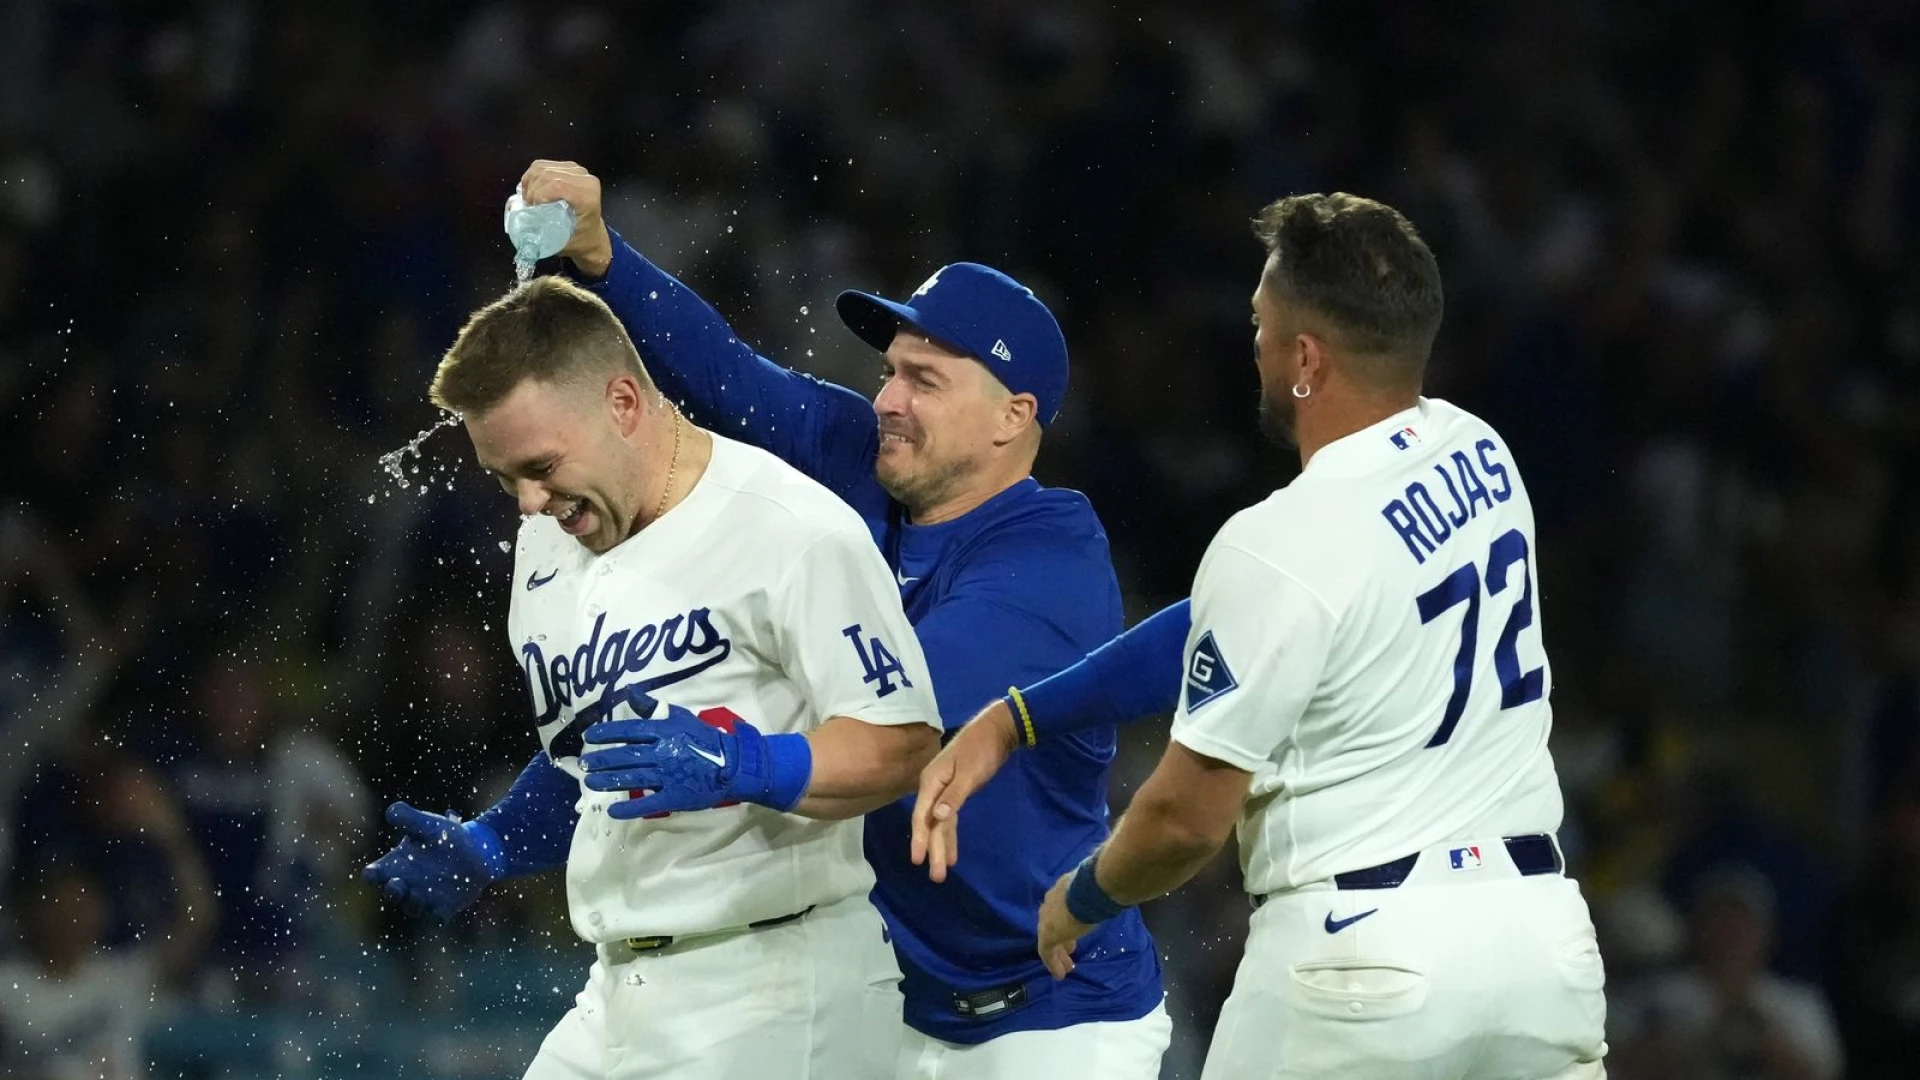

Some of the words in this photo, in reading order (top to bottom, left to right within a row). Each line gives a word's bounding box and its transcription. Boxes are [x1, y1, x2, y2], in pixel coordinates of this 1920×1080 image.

[1381, 438, 1512, 565] ROJAS
[522, 606, 730, 729] Dodgers
[842, 624, 913, 698] LA
[1416, 528, 1543, 749] 72
